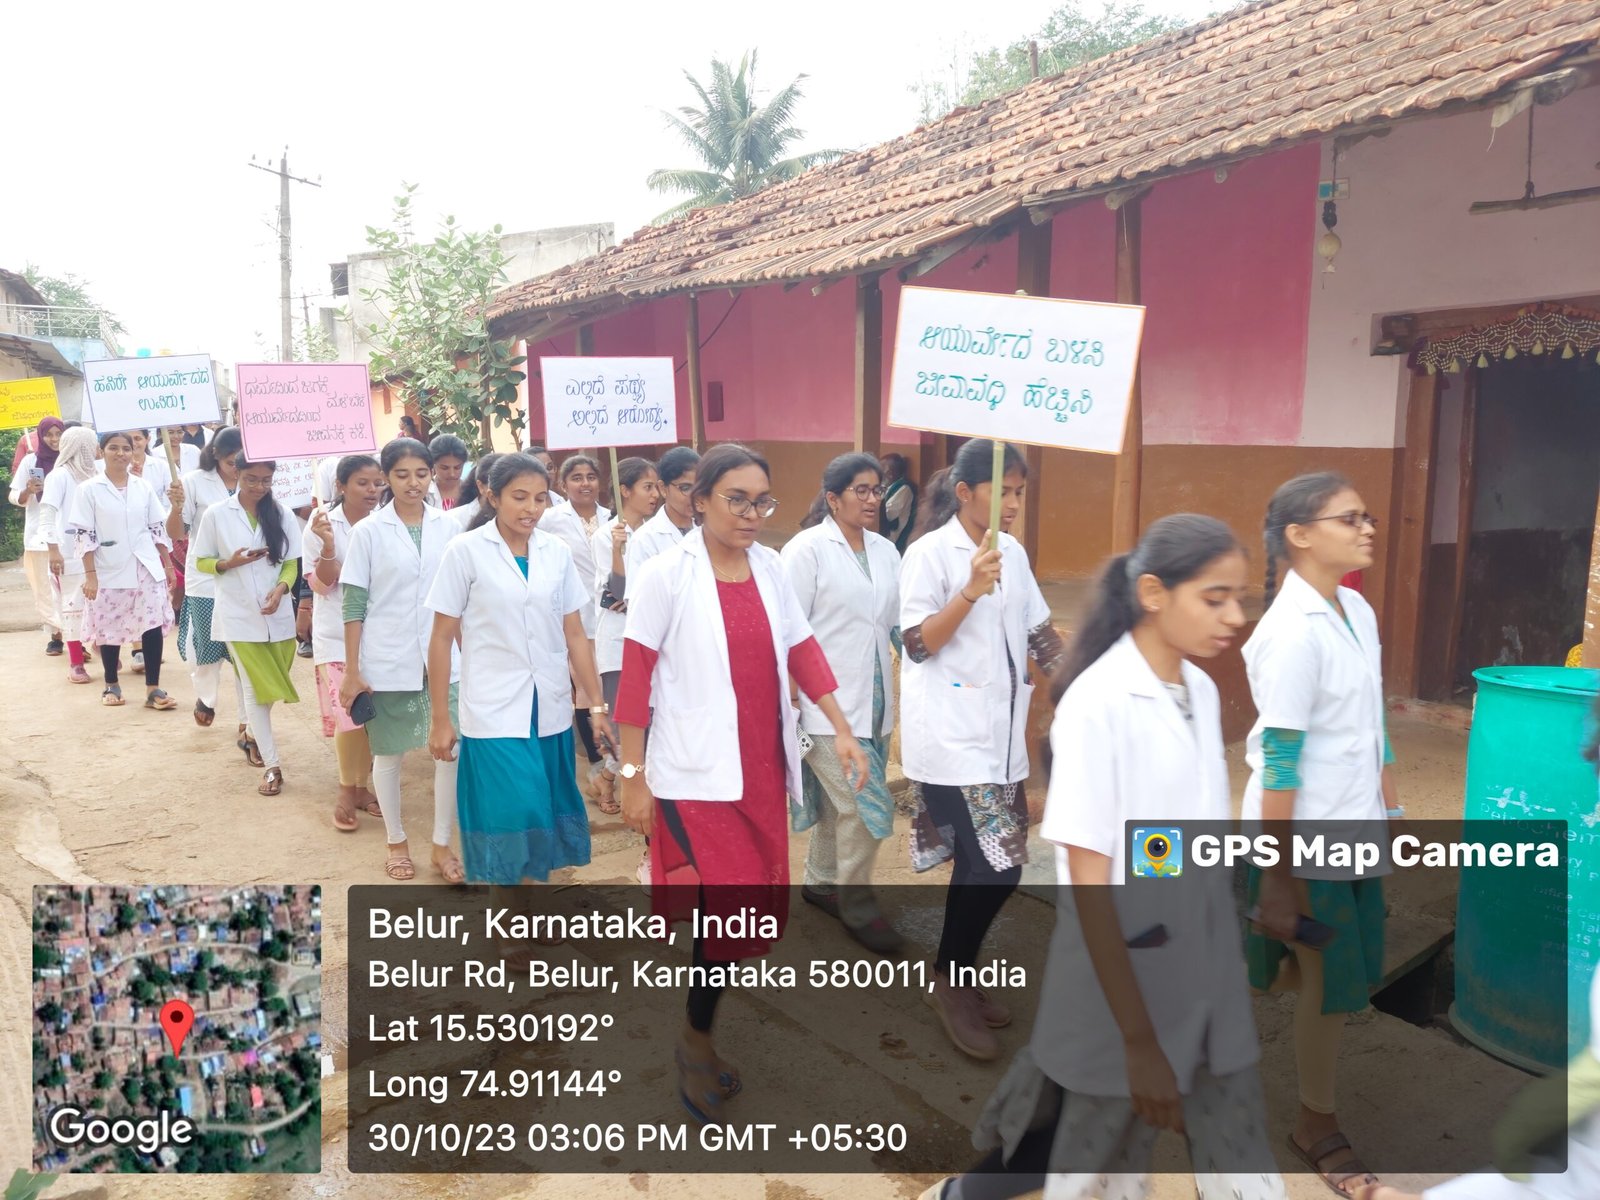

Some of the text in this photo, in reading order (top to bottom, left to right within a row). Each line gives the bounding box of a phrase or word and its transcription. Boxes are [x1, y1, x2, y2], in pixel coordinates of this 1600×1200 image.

[919, 323, 1105, 367] ಆಯುರ್ವೇದ ಬಳಸಿ
[565, 375, 605, 405] ಎಲ್ಲಿದೆ
[1023, 377, 1093, 423] ಹೆಚ್ಚಿಸಿ
[567, 404, 609, 435] ಅಲ್ಲಿದೆ
